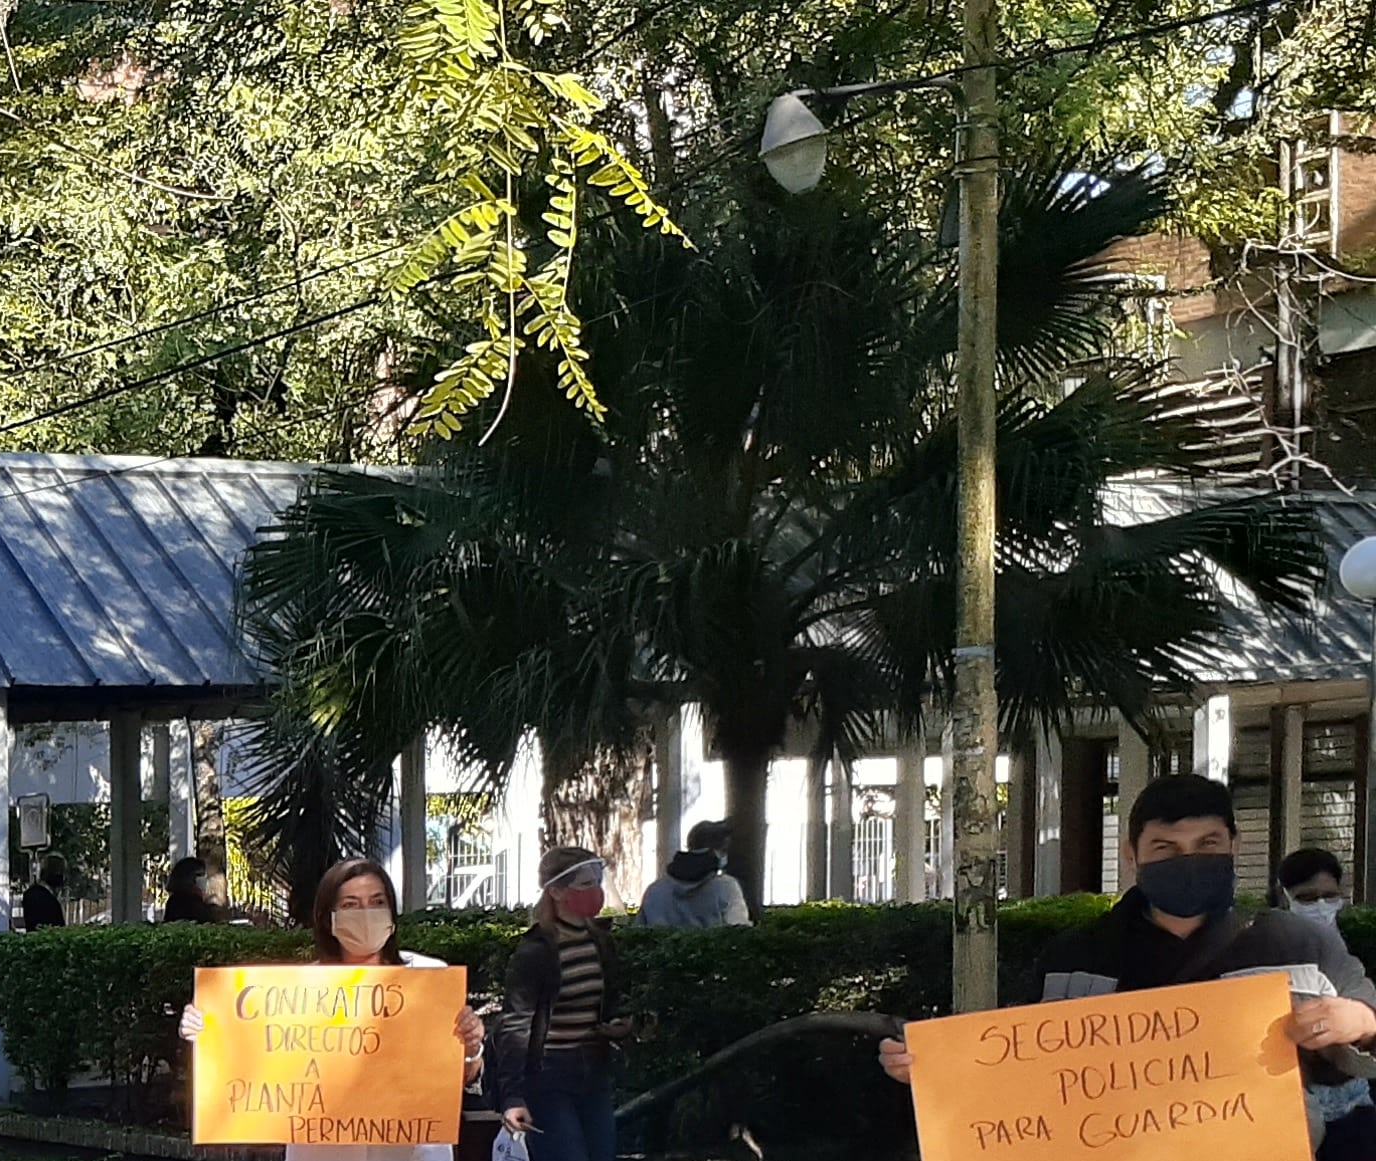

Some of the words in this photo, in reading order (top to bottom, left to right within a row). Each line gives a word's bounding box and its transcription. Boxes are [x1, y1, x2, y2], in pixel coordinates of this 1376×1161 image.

[236, 984, 405, 1020] CONTRATOS
[265, 1024, 380, 1055] DIRECTOS
[975, 1007, 1200, 1067] SEGURIDAD
[305, 1058, 320, 1079] A
[1056, 1051, 1241, 1105] POLICIAL
[226, 1079, 326, 1114] PLANTA
[289, 1117, 442, 1144] PERMANENTE
[970, 1115, 1053, 1150] PARA
[1078, 1093, 1255, 1148] GUARDIA
